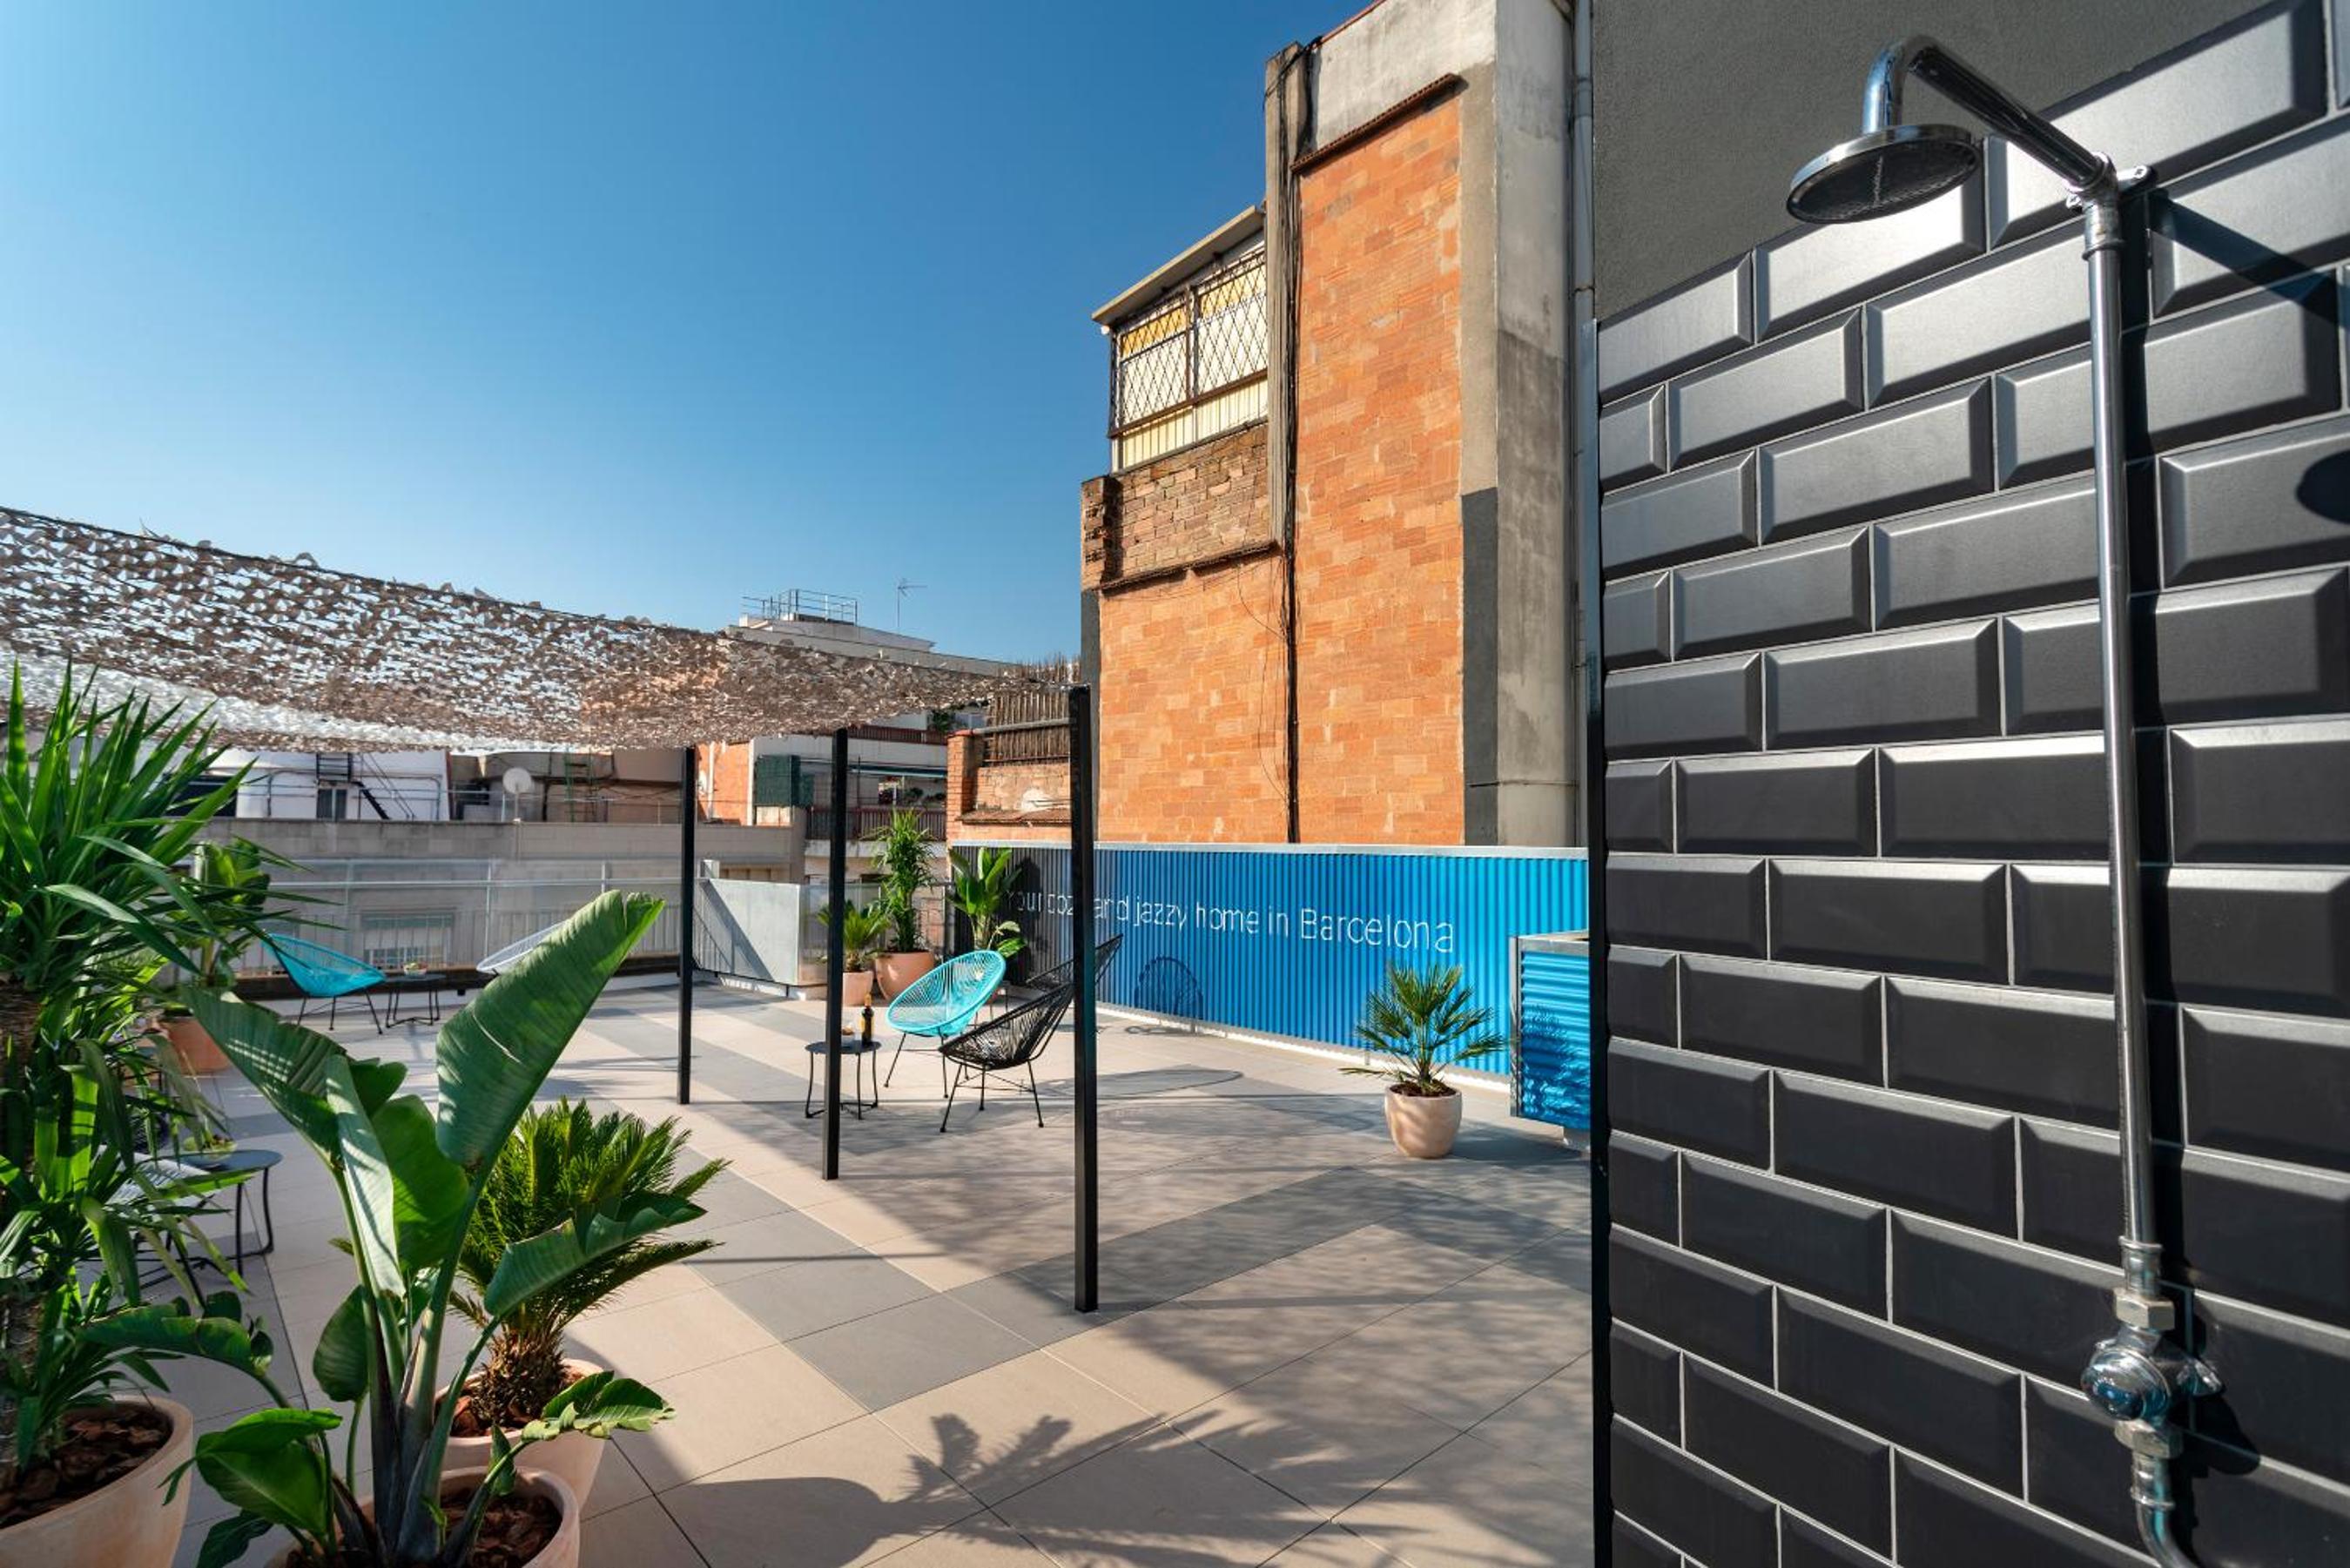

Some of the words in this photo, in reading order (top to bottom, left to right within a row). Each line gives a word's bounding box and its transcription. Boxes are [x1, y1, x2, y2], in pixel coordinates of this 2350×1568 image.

[1047, 893, 1074, 916] coz
[1094, 895, 1129, 921] and
[1134, 895, 1188, 932] jazzy
[1195, 901, 1259, 934] home
[1268, 905, 1289, 938] in
[1301, 908, 1453, 953] Barcelona
